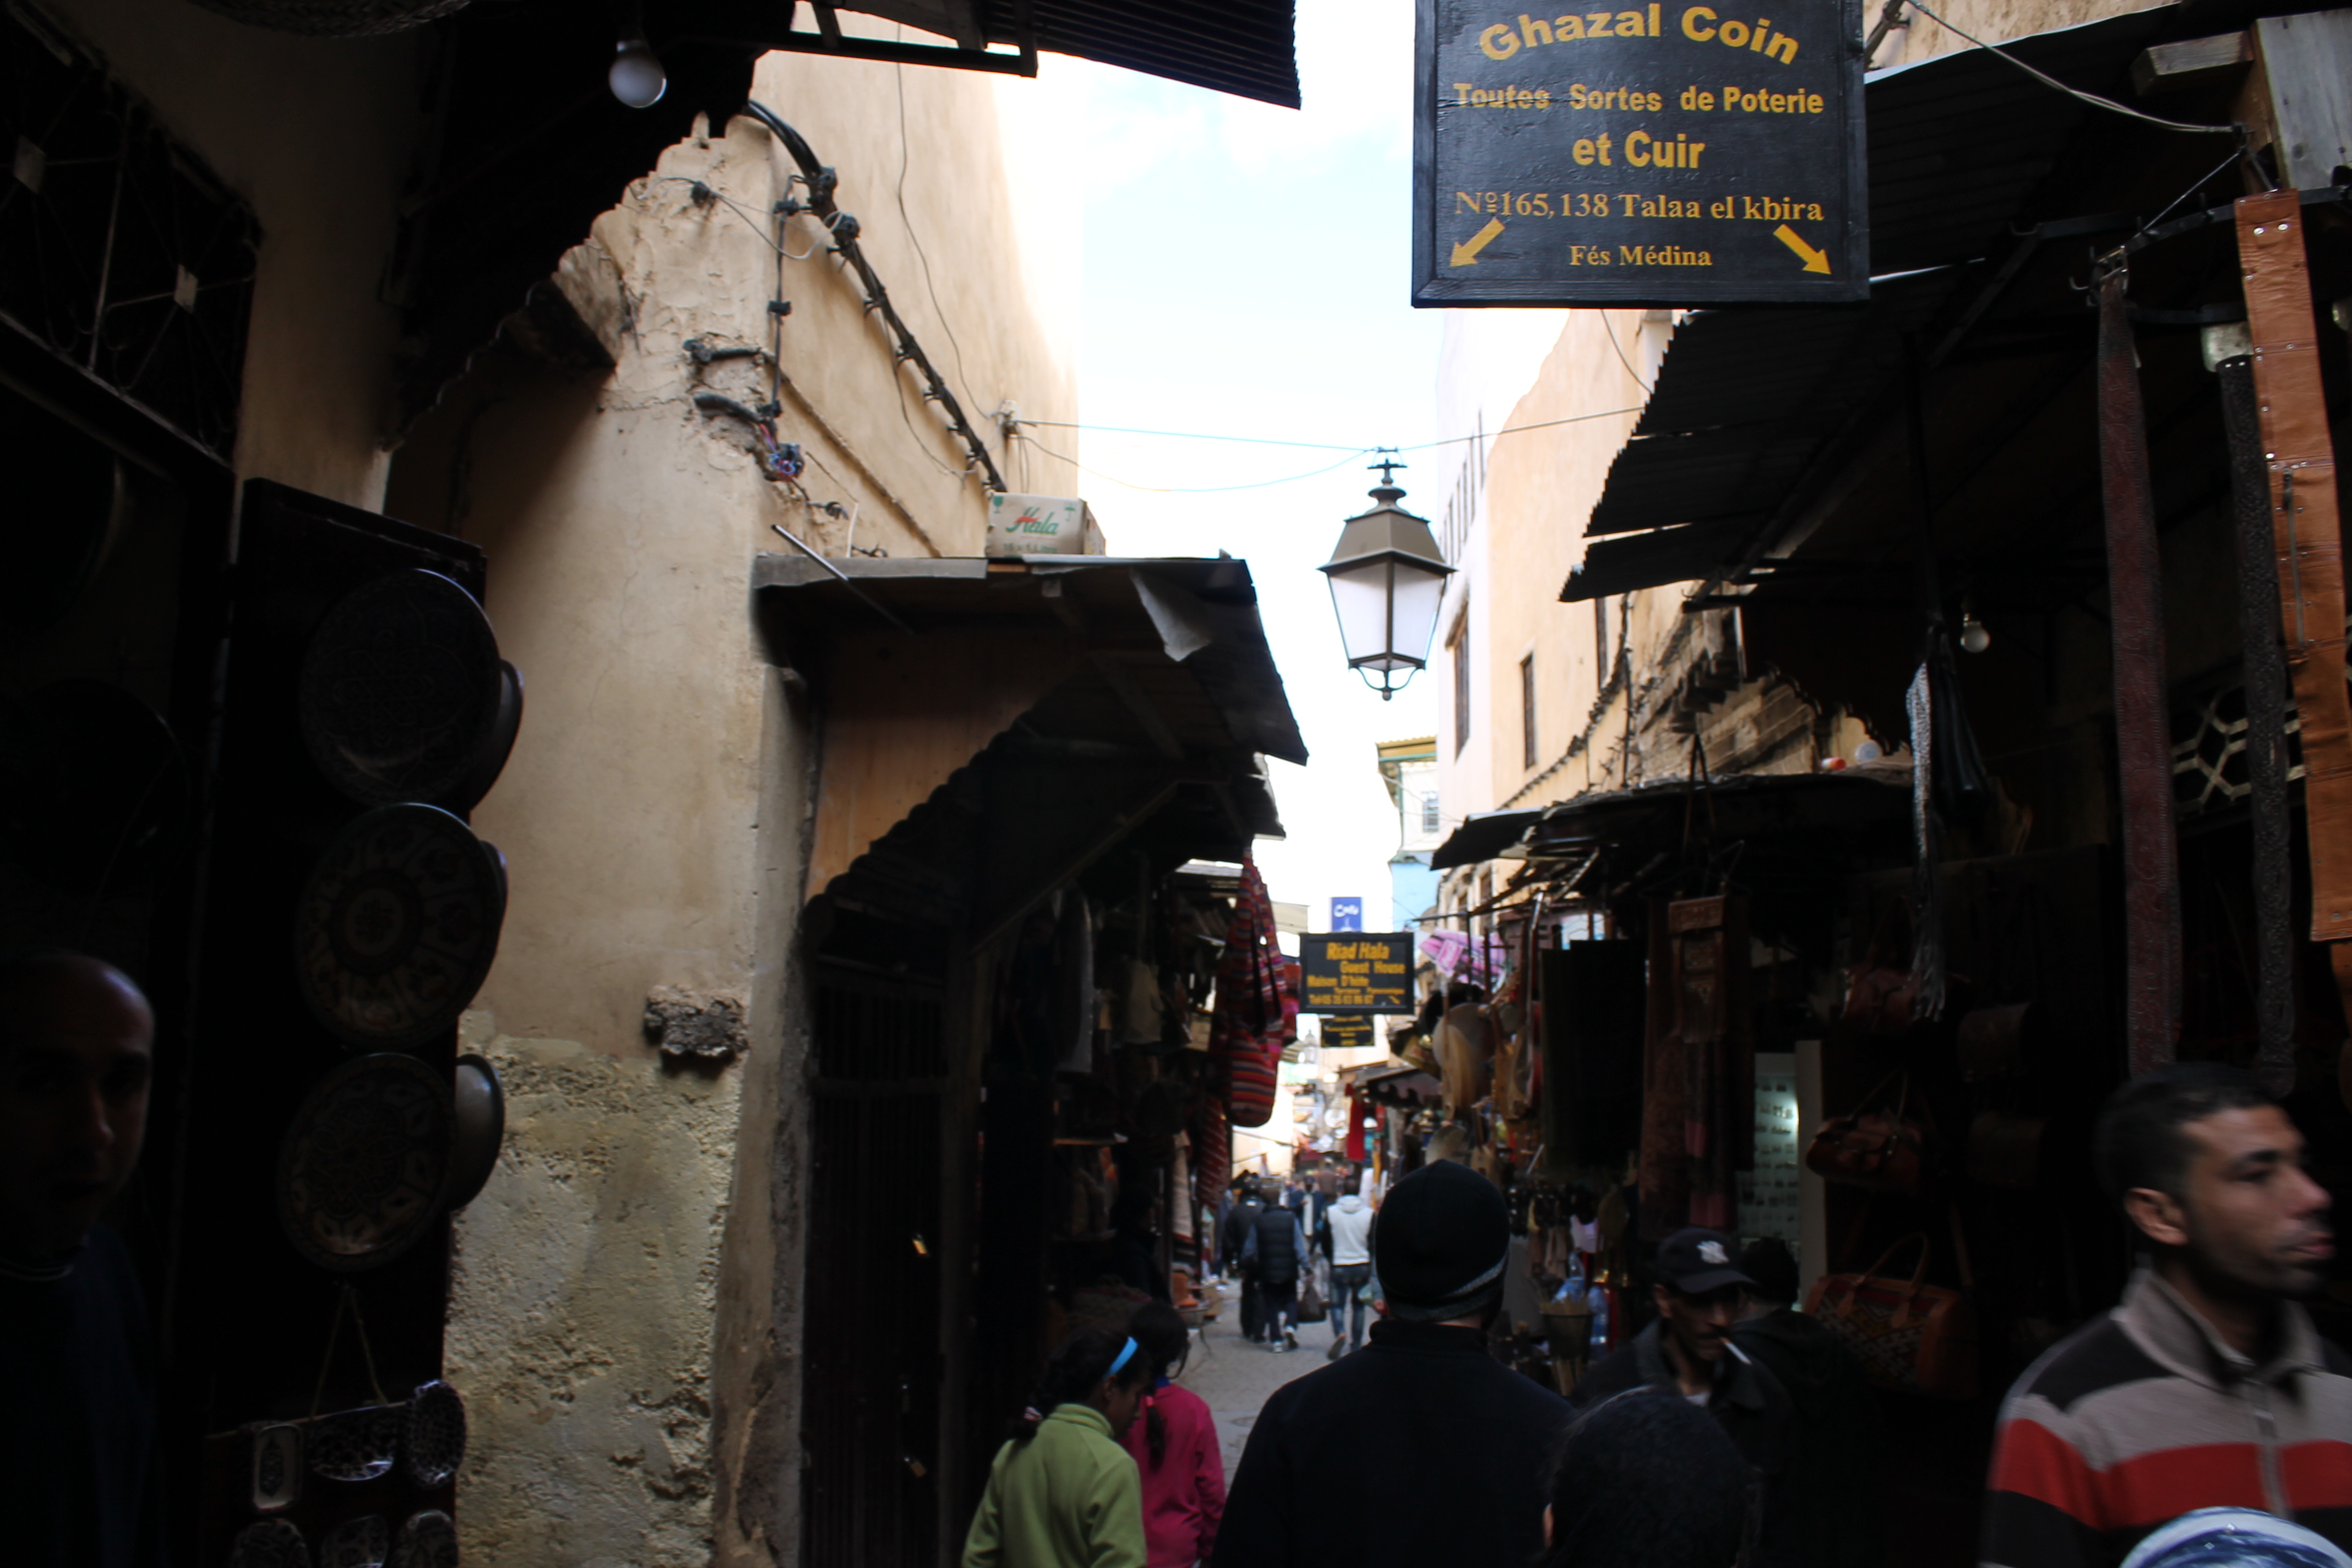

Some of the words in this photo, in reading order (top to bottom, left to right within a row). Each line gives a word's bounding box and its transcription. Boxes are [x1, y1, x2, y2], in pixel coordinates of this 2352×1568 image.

[1479, 3, 1660, 61] Ghazal
[1681, 6, 1799, 64] Coin
[1453, 83, 1550, 109] Toutes
[1569, 84, 1663, 112] Sortes
[1680, 86, 1714, 111] de
[1723, 86, 1824, 113] Poterie
[1572, 133, 1612, 166] et
[1624, 130, 1706, 168] Cuir
[1618, 194, 1701, 219] Talaa
[1709, 196, 1735, 219] el
[1744, 197, 1825, 221] kbira
[1569, 245, 1610, 266] Fés
[1619, 245, 1713, 266] Médina
[1006, 506, 1060, 535] Hala
[1326, 941, 1358, 960] Riad
[1358, 941, 1391, 960] Hala
[1340, 960, 1370, 974] Guest
[1373, 960, 1406, 974] House
